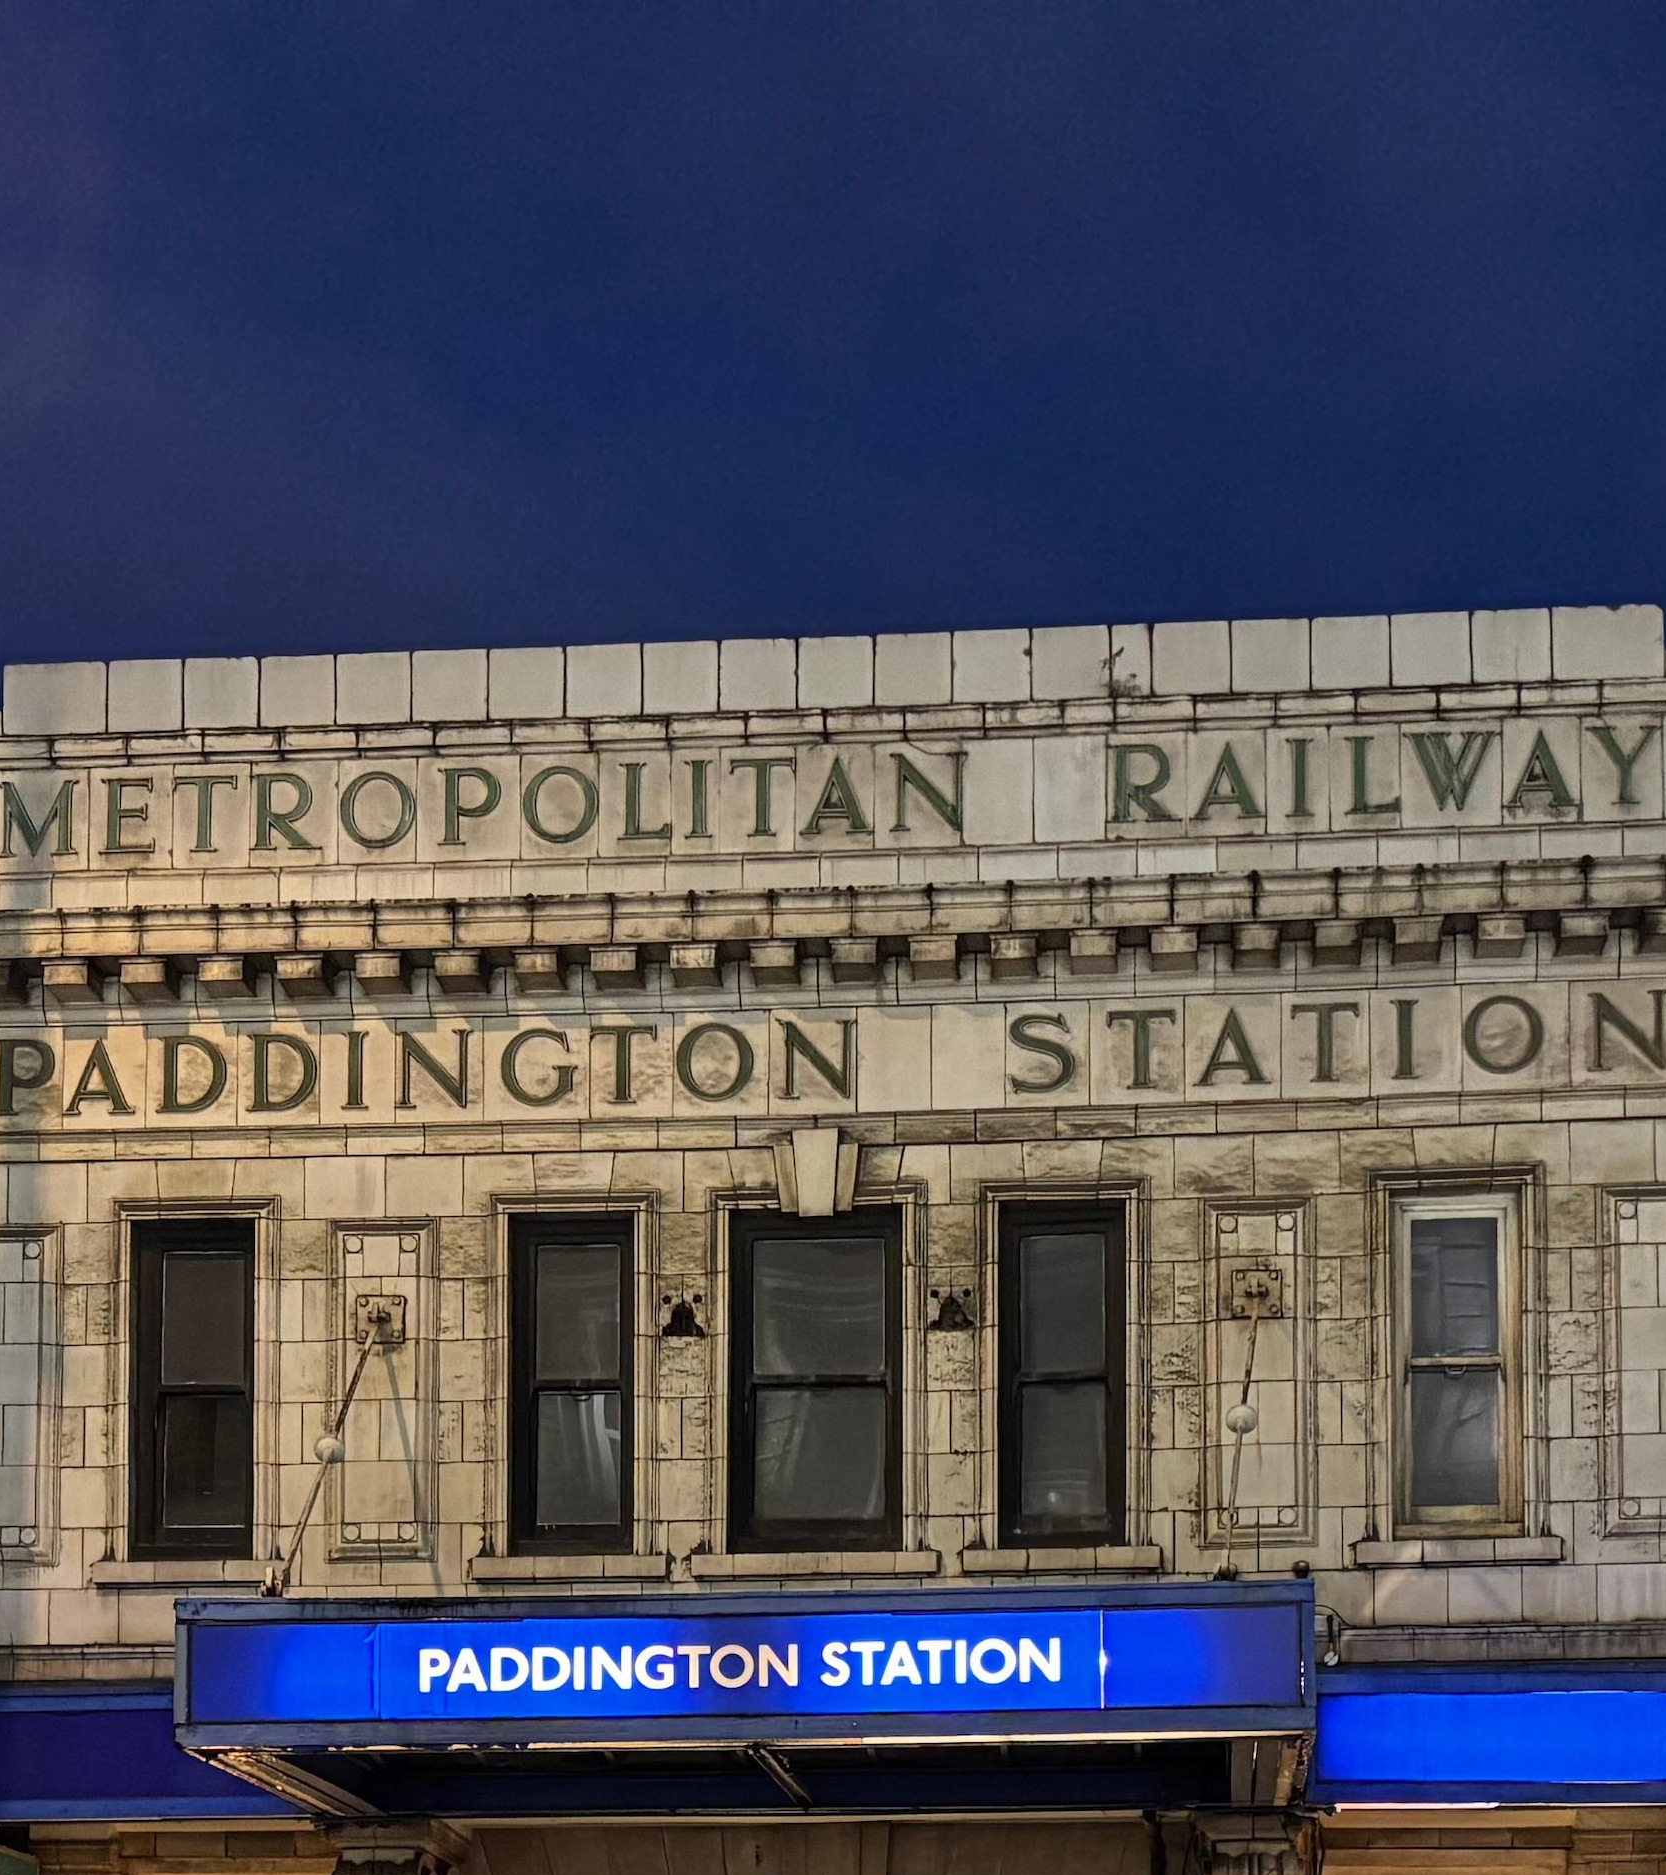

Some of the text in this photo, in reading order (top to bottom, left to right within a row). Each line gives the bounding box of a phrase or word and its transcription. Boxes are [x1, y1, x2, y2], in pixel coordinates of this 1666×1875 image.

[1106, 725, 1661, 823] RAILWAY
[418, 1637, 1061, 1693] PADDINGTON STATION
